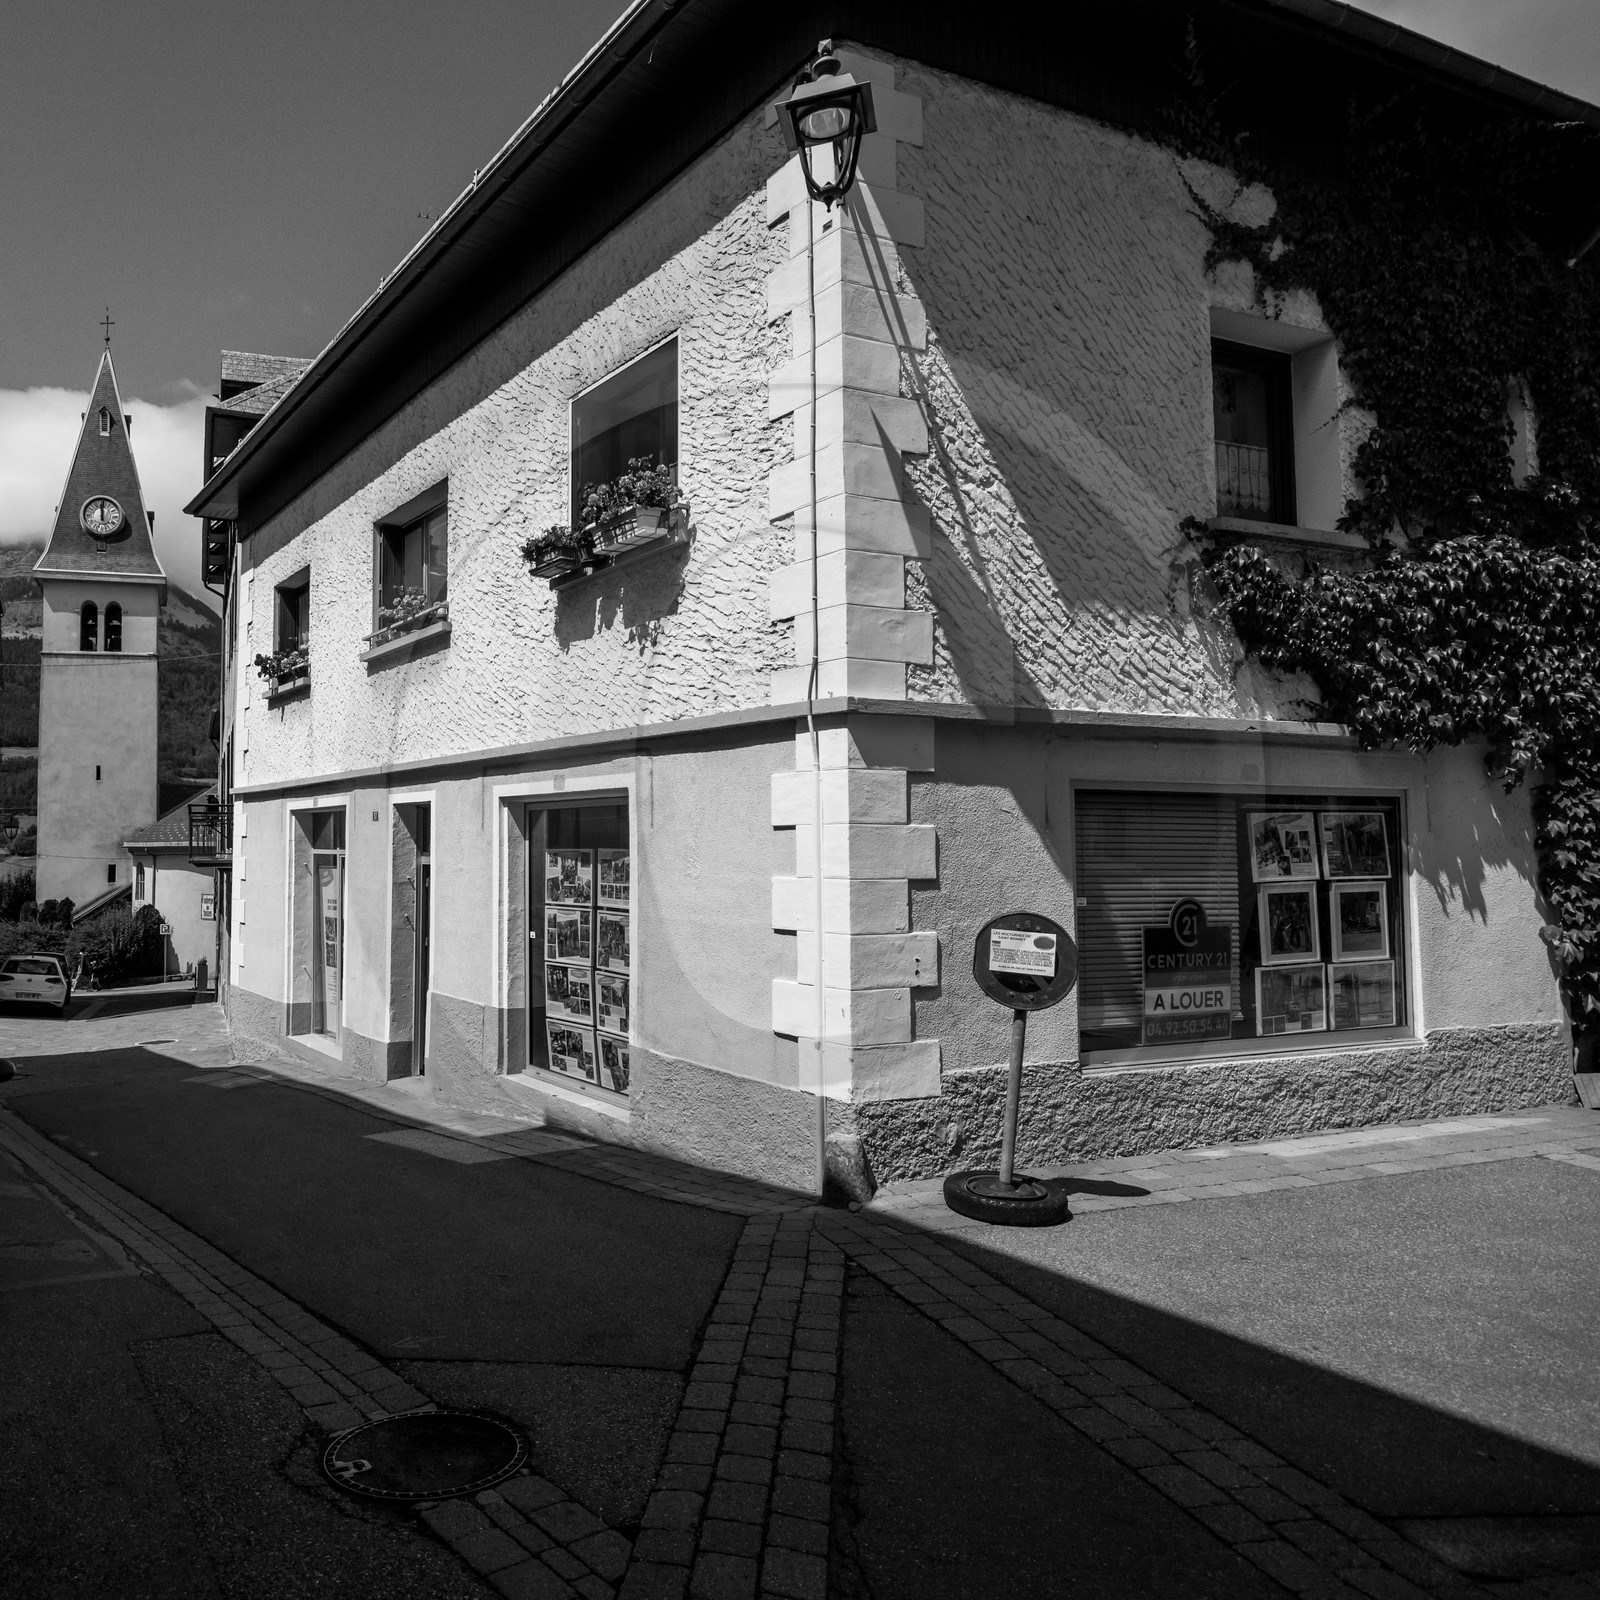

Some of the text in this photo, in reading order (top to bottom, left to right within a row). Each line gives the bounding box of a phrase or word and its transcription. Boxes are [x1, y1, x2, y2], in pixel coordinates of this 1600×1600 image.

[1147, 952, 1227, 968] CENTURY 21
[1153, 990, 1224, 1011] A LOUER
